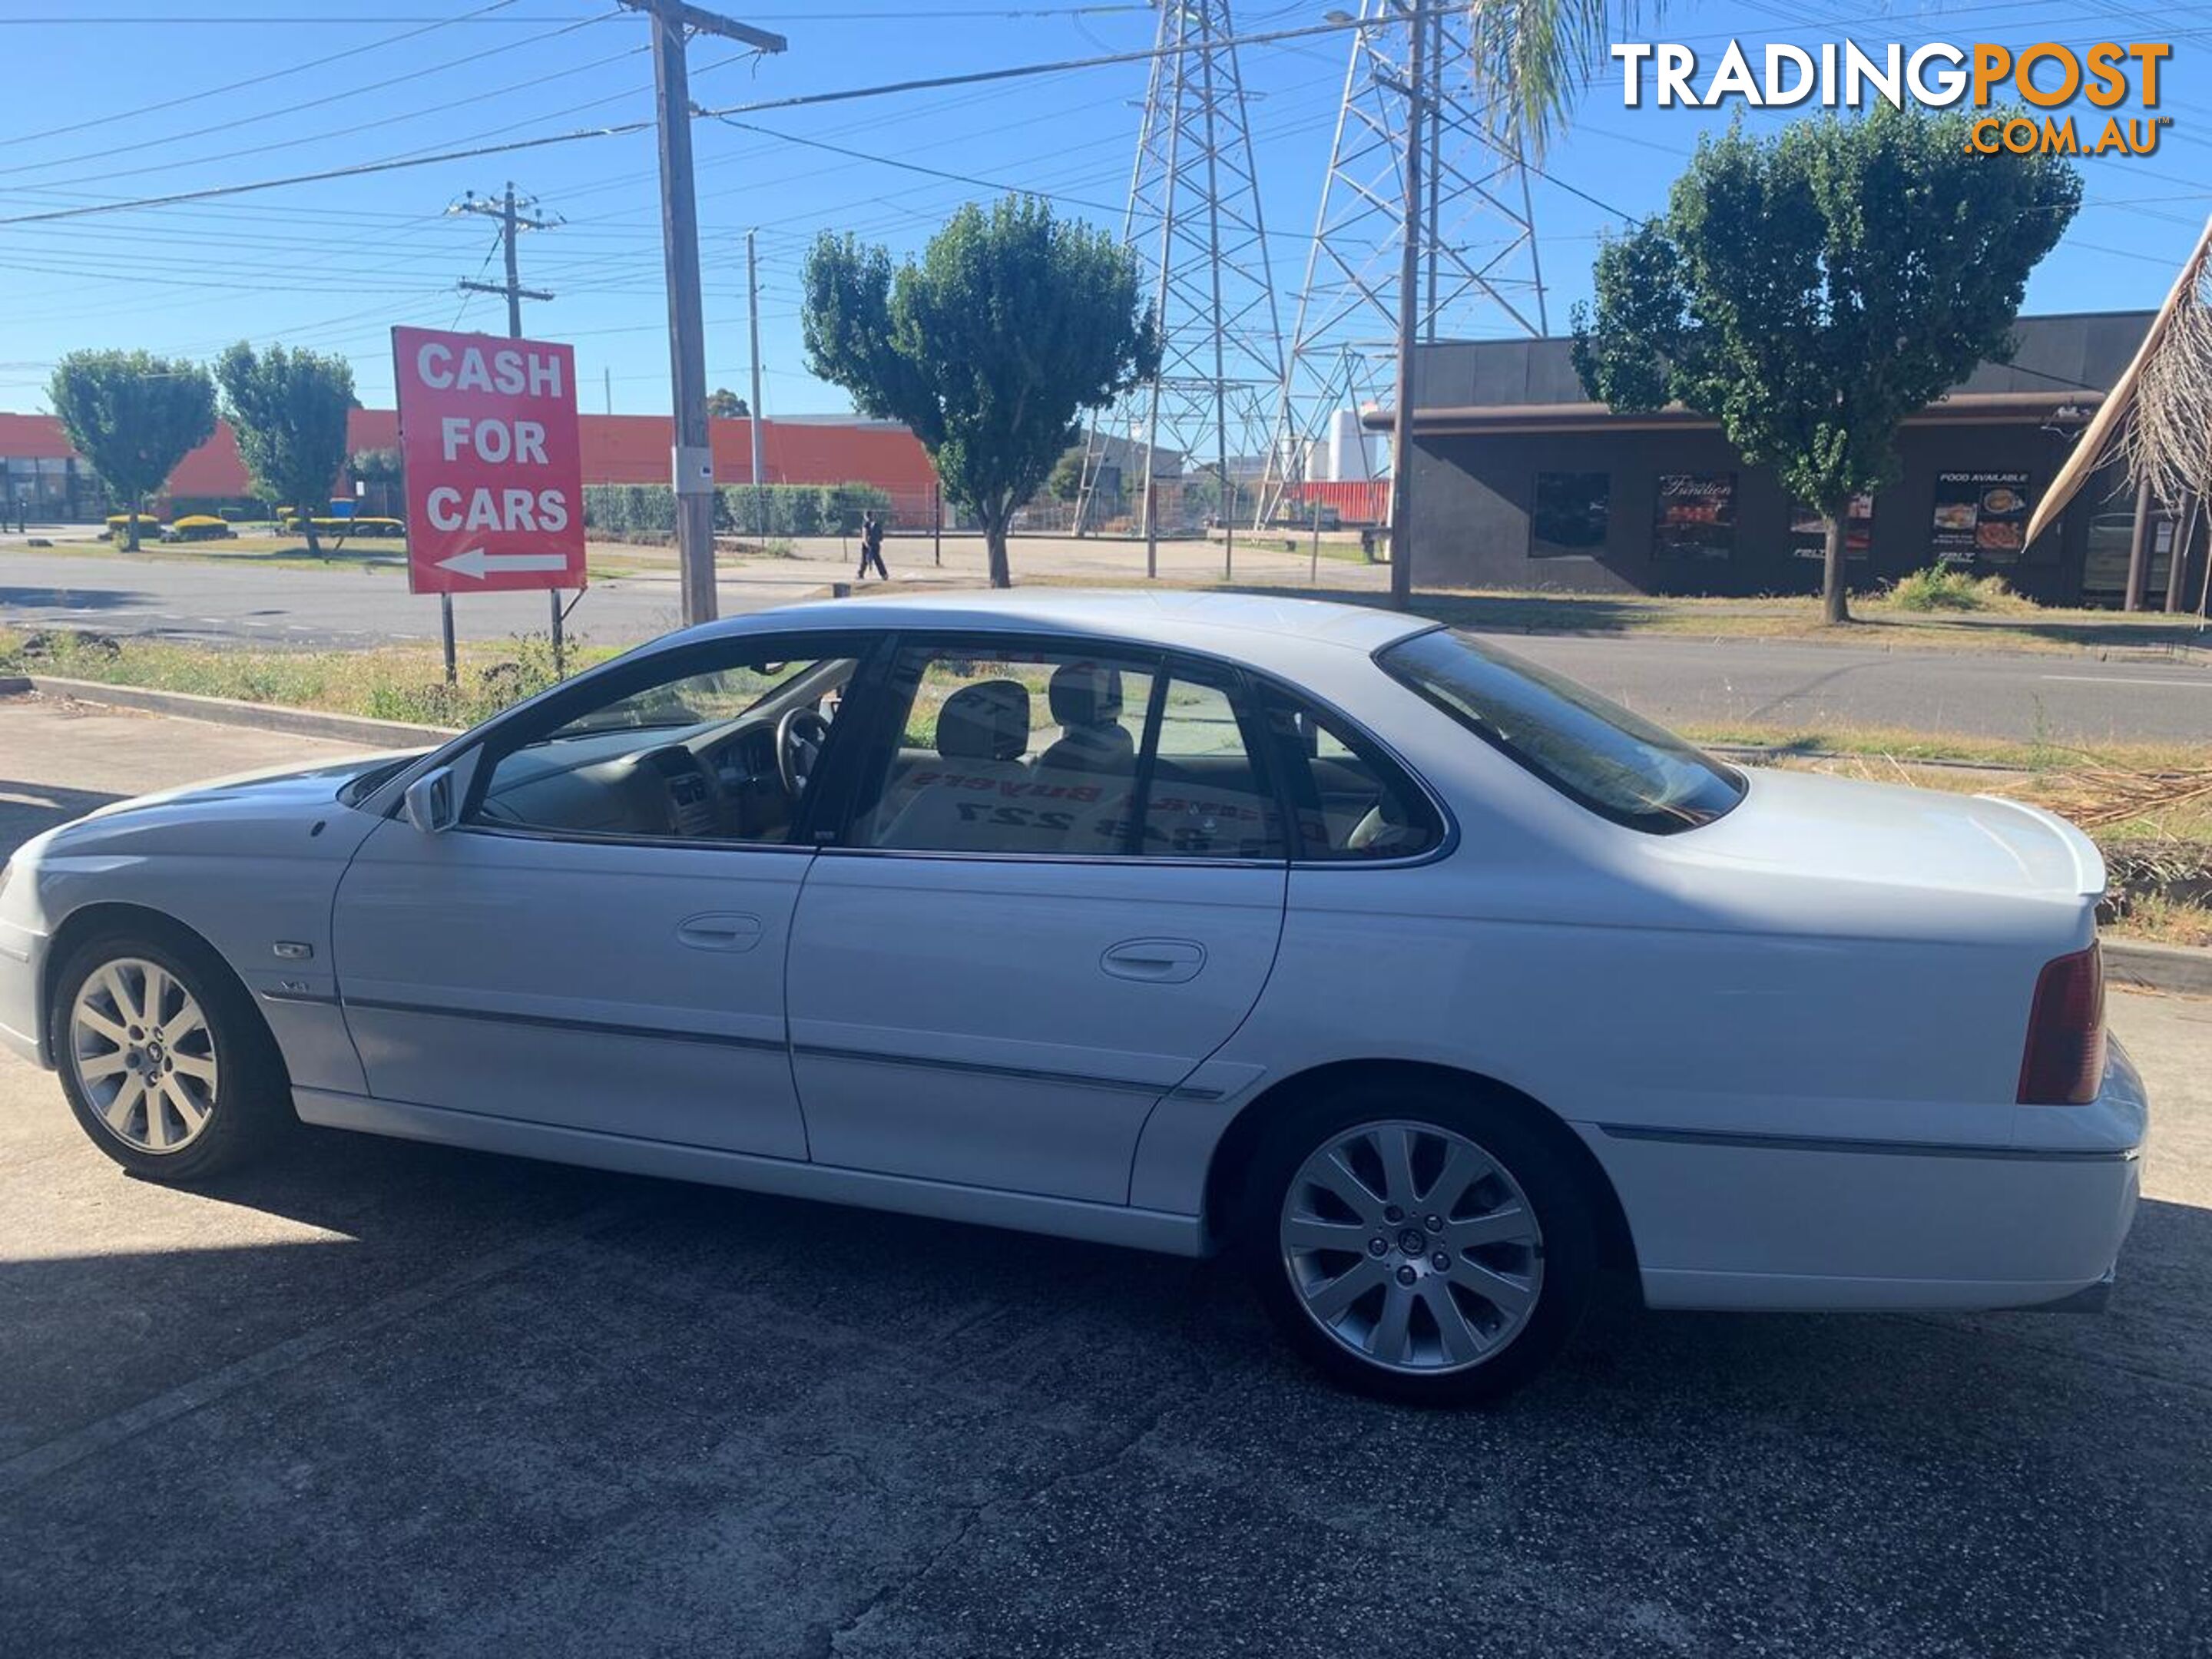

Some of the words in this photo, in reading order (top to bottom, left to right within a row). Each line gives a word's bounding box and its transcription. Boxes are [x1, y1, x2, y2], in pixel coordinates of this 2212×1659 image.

[417, 343, 563, 398] CASH
[441, 417, 549, 464] FOR
[1939, 473, 1970, 482] FOOD
[1971, 473, 2029, 482] AVAILABLE
[427, 486, 568, 532] CARS
